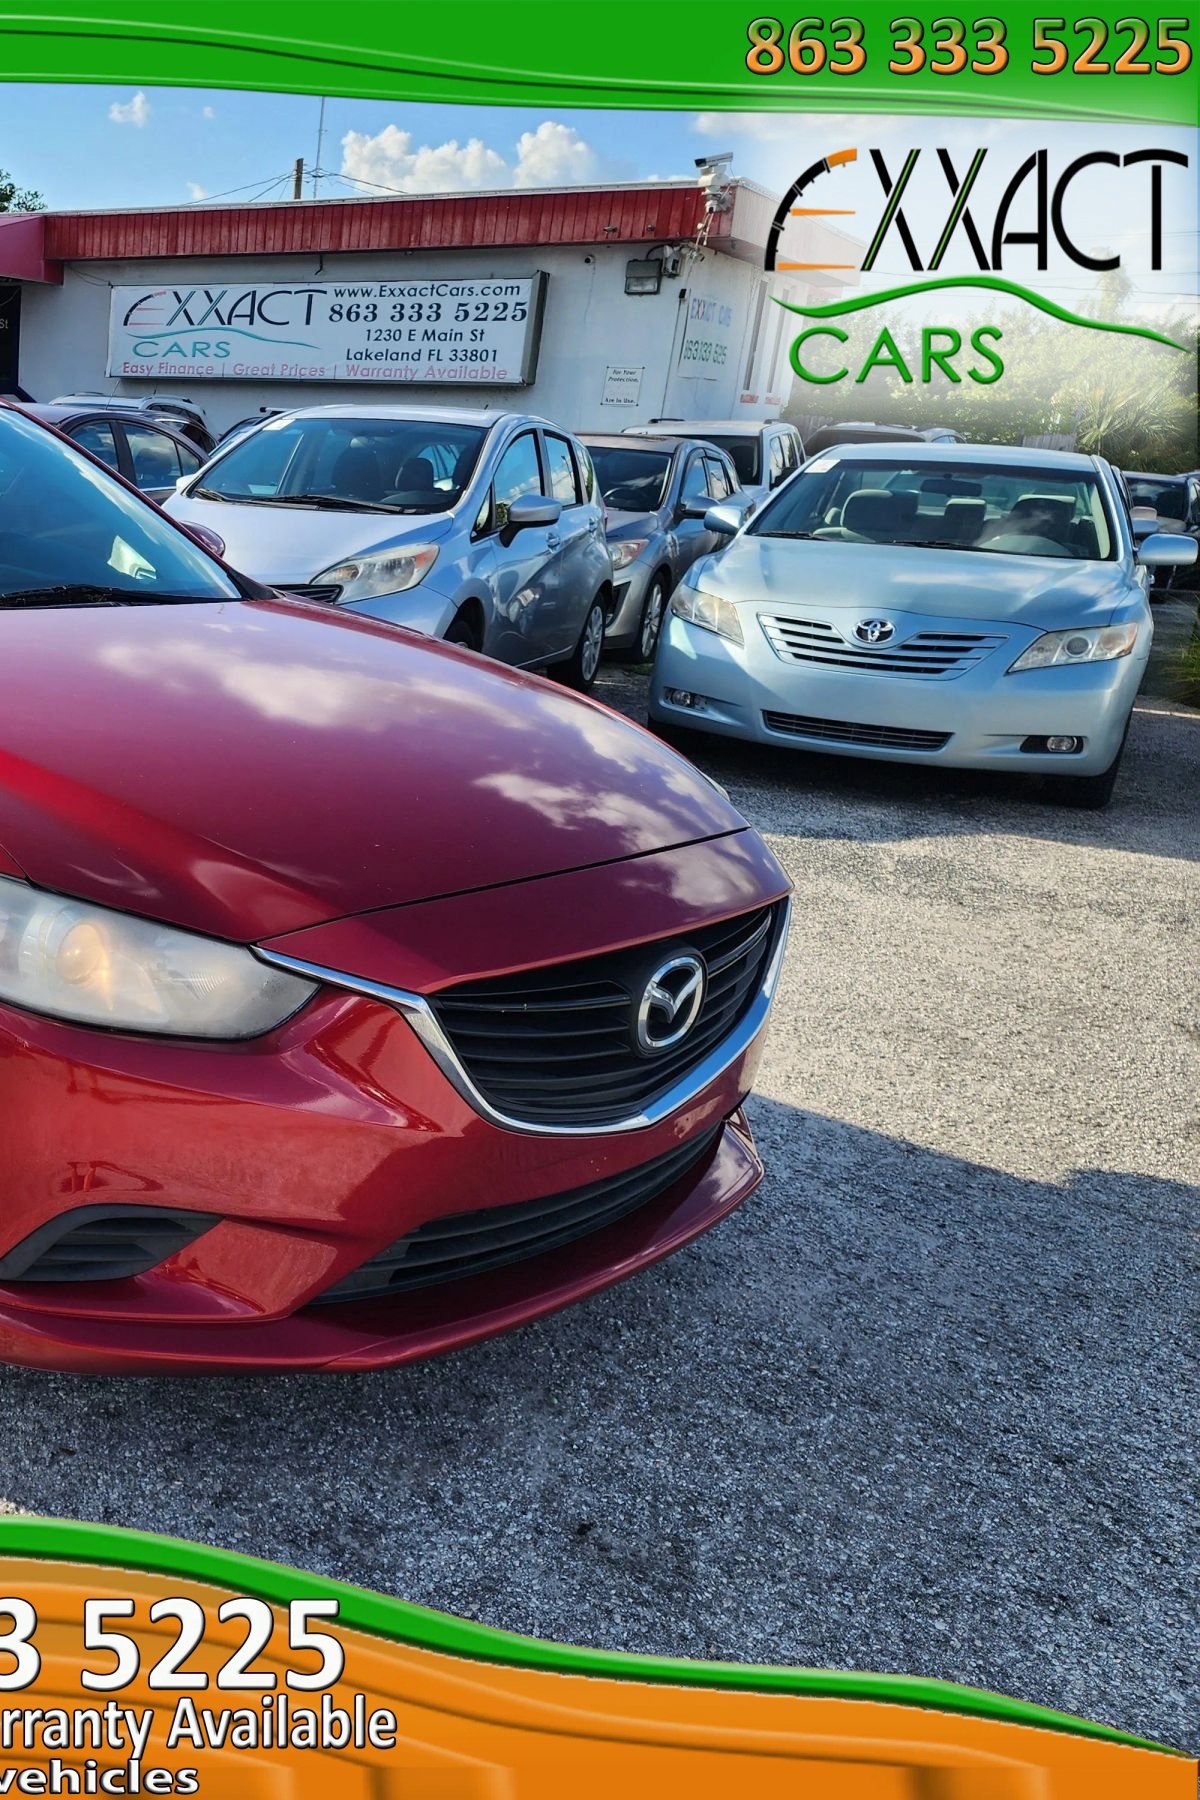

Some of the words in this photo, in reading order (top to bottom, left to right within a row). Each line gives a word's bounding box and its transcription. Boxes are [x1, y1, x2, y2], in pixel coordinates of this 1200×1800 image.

[334, 284, 520, 298] www.ExxactCars.com
[123, 289, 327, 326] EXXACT
[328, 303, 378, 322] 863
[390, 302, 442, 322] 333
[454, 301, 528, 322] 5225
[366, 329, 401, 342] 1230
[408, 329, 416, 342] E
[421, 329, 463, 342] Main
[470, 329, 486, 342] St
[132, 341, 231, 358] CARS
[346, 348, 421, 362] Lakeland
[427, 349, 443, 362] FL
[449, 349, 498, 362] 33801
[122, 362, 153, 377] Easy
[158, 362, 214, 375] Finance
[233, 363, 276, 376] Great
[282, 363, 325, 377] Prices
[346, 364, 418, 380] Warranty
[424, 364, 508, 380] Available
